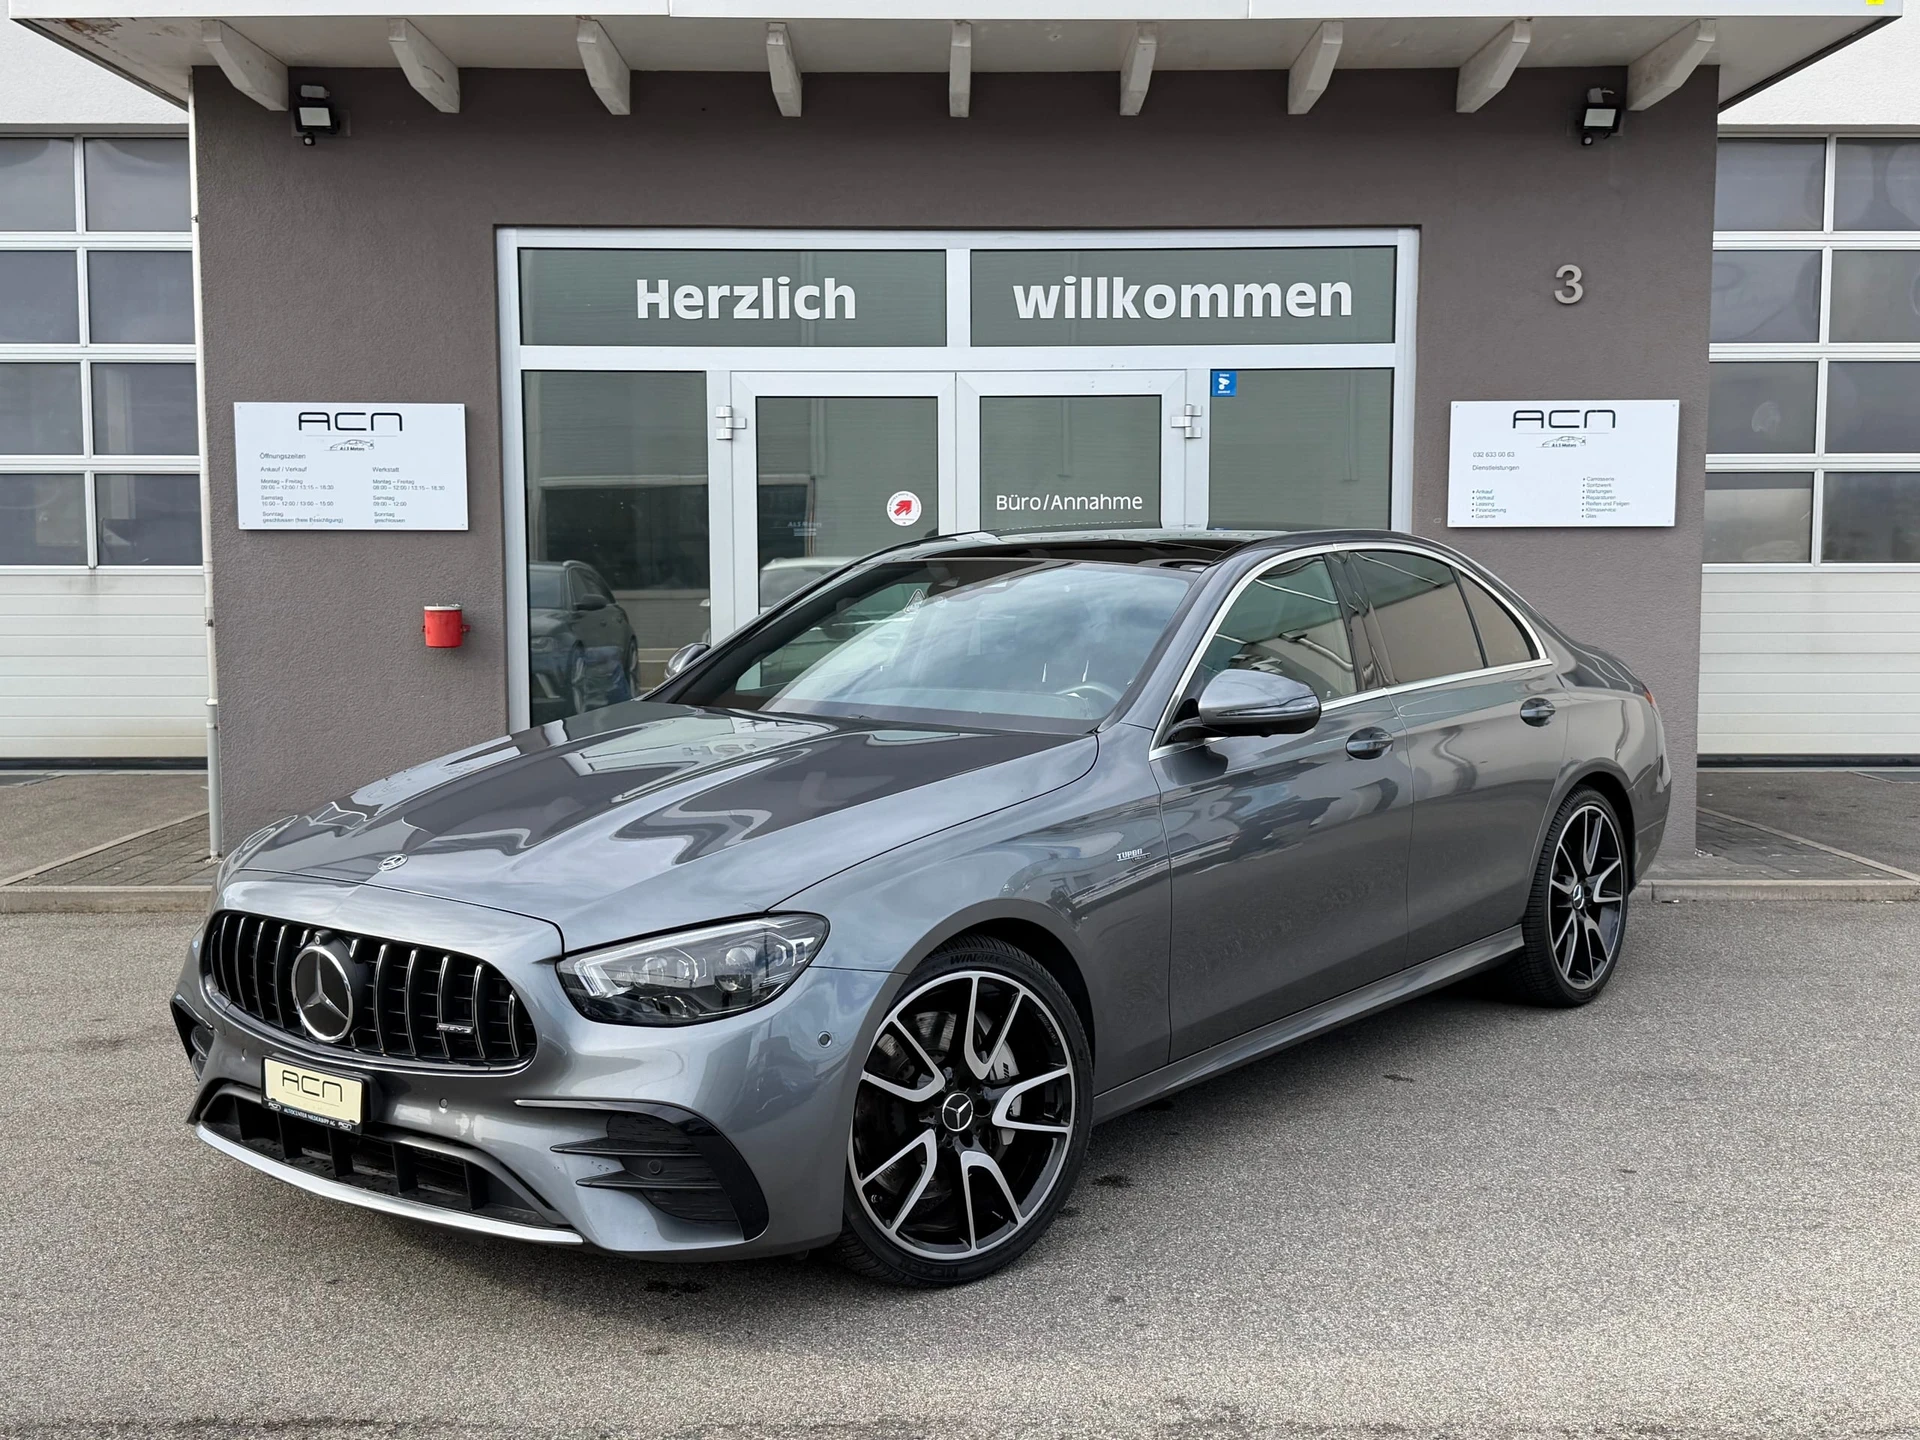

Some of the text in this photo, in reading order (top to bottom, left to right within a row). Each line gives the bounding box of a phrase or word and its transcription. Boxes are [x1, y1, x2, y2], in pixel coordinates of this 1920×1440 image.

[1554, 264, 1583, 304] 3
[636, 275, 1352, 320] Herzlich willkommen
[298, 412, 403, 431] ACN
[1512, 410, 1616, 429] ACN
[259, 452, 306, 460] Öffnungszeiten
[996, 494, 1143, 511] Büro/Annahme
[1116, 848, 1143, 861] TURBO
[282, 1069, 343, 1102] ACN
[283, 1107, 307, 1119] AUTOCENTER
